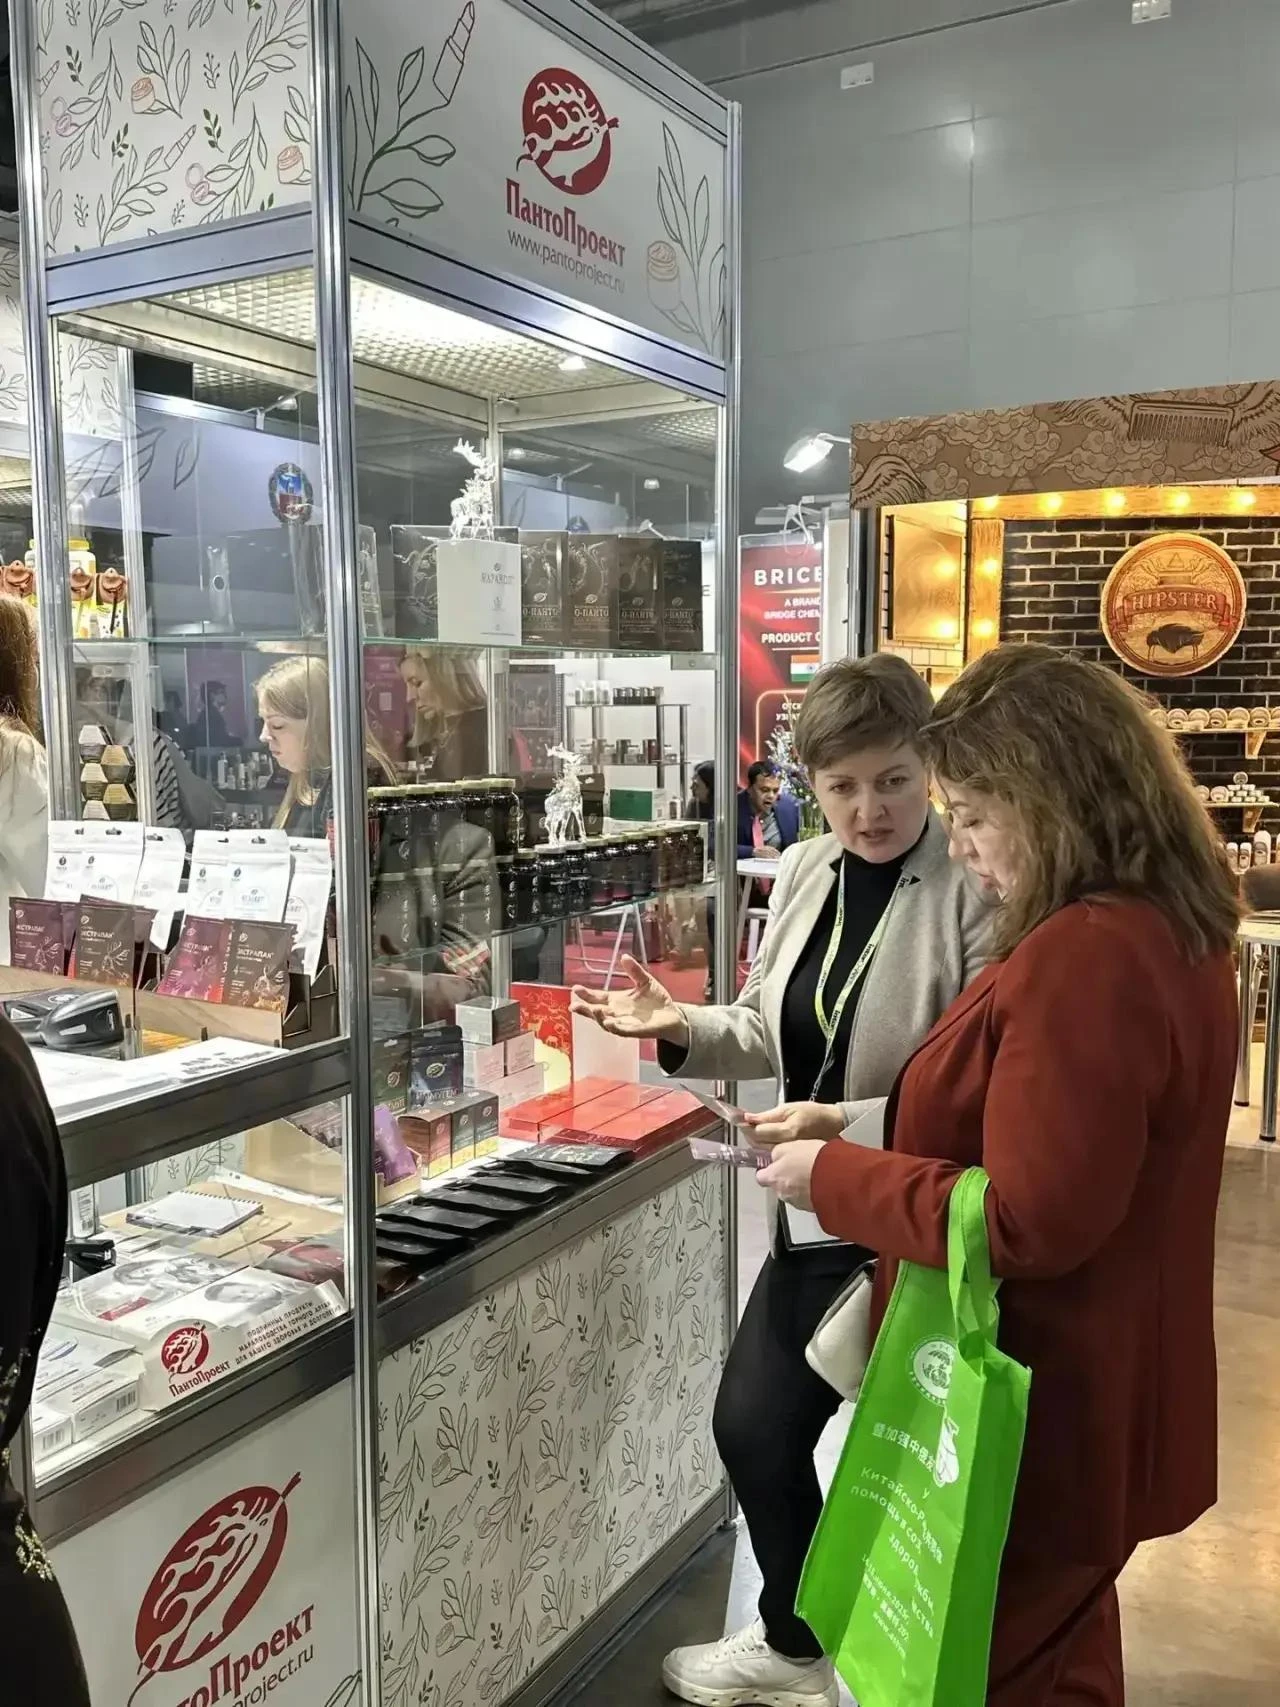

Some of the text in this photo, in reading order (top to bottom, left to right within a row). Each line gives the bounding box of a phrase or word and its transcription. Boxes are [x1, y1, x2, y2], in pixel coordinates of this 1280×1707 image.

[506, 178, 625, 267] ПантоПроект
[507, 230, 625, 293] www.pantoproject.ru
[1132, 592, 1217, 610] HIPSTER
[764, 610, 796, 620] BRIDGE
[761, 632, 813, 644] PRODUCT
[284, 1301, 314, 1320] ПРОДУКТЫ
[289, 1311, 314, 1328] ГОРНОГО
[249, 1342, 272, 1358] ВАШЕГО
[169, 1361, 231, 1397] ПантоПроект
